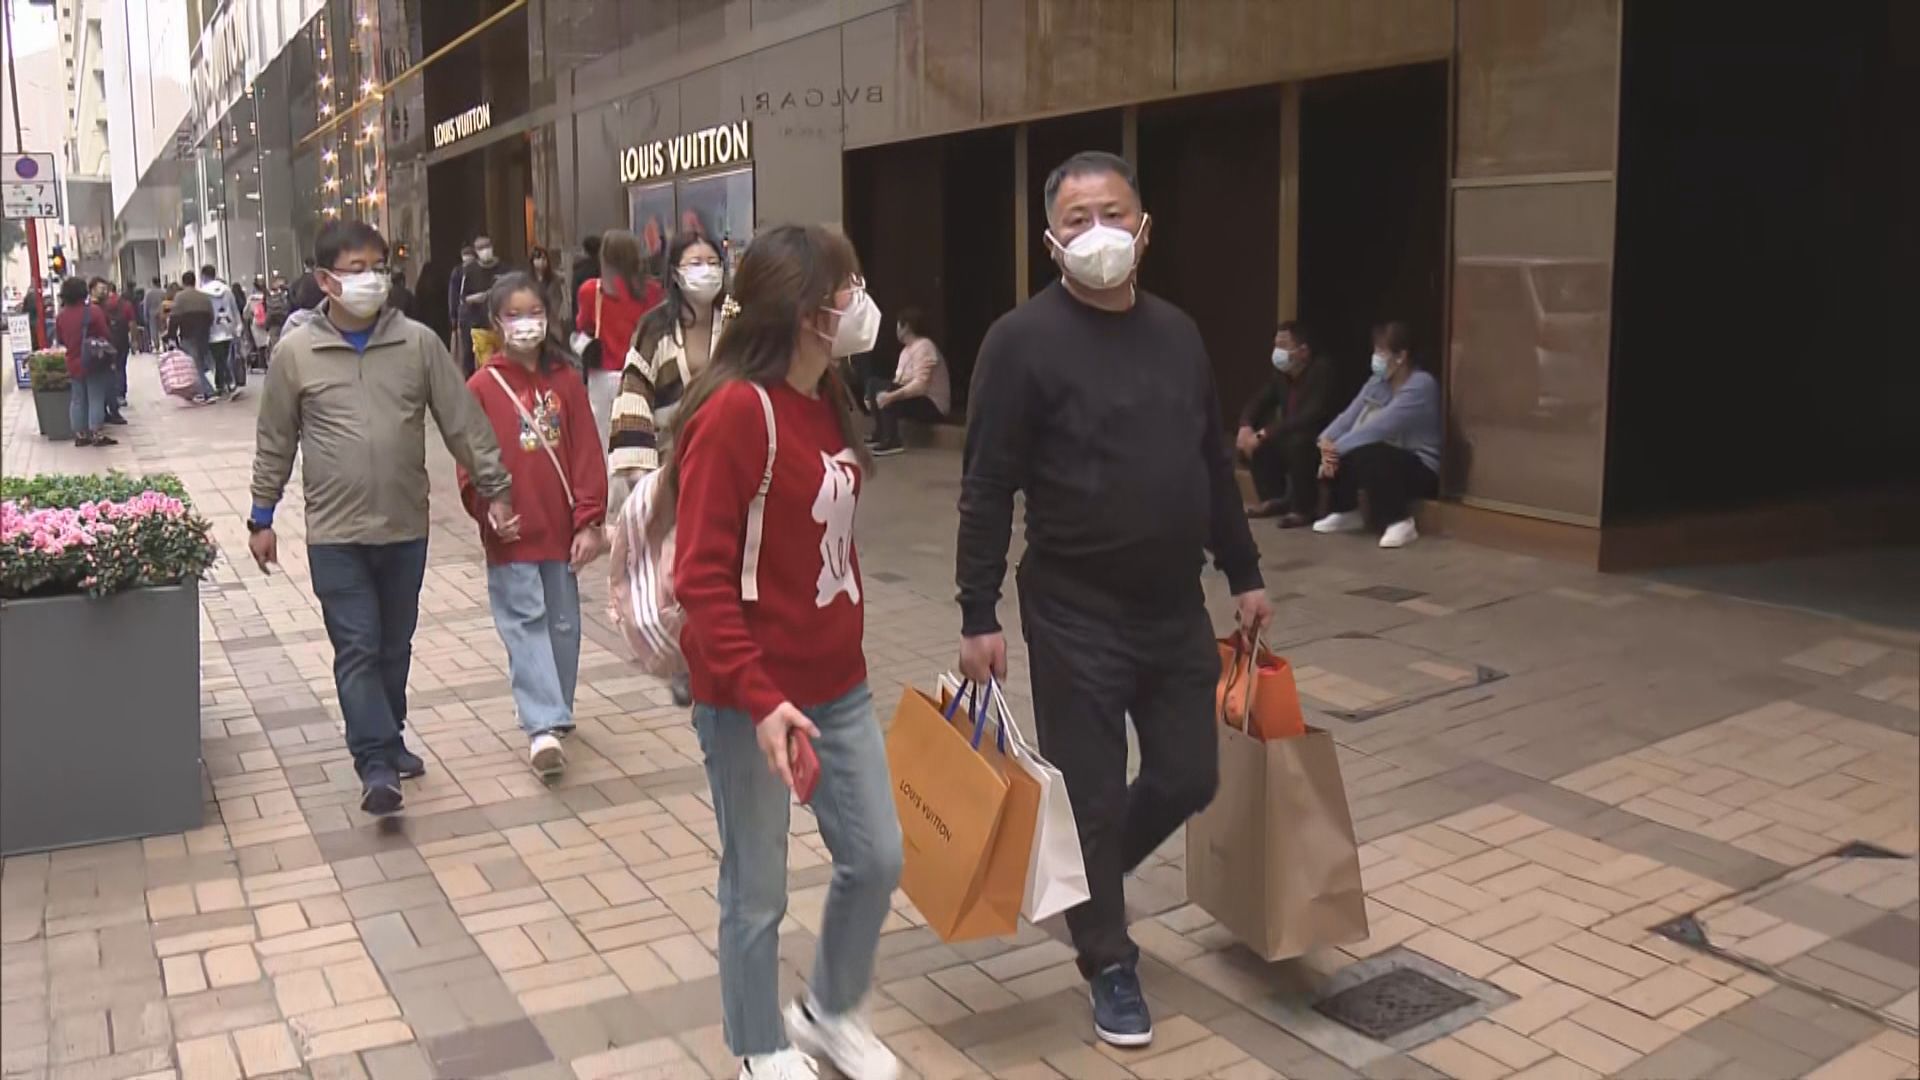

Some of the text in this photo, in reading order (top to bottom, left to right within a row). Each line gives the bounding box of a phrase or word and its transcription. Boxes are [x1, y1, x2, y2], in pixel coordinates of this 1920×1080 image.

[433, 102, 491, 148] LOUIS VUITTON
[620, 119, 749, 183] LOUIS VUITTON
[35, 184, 44, 196] 7
[38, 203, 53, 215] 12
[899, 779, 922, 809] LOUIS
[922, 803, 952, 843] VUITTON
